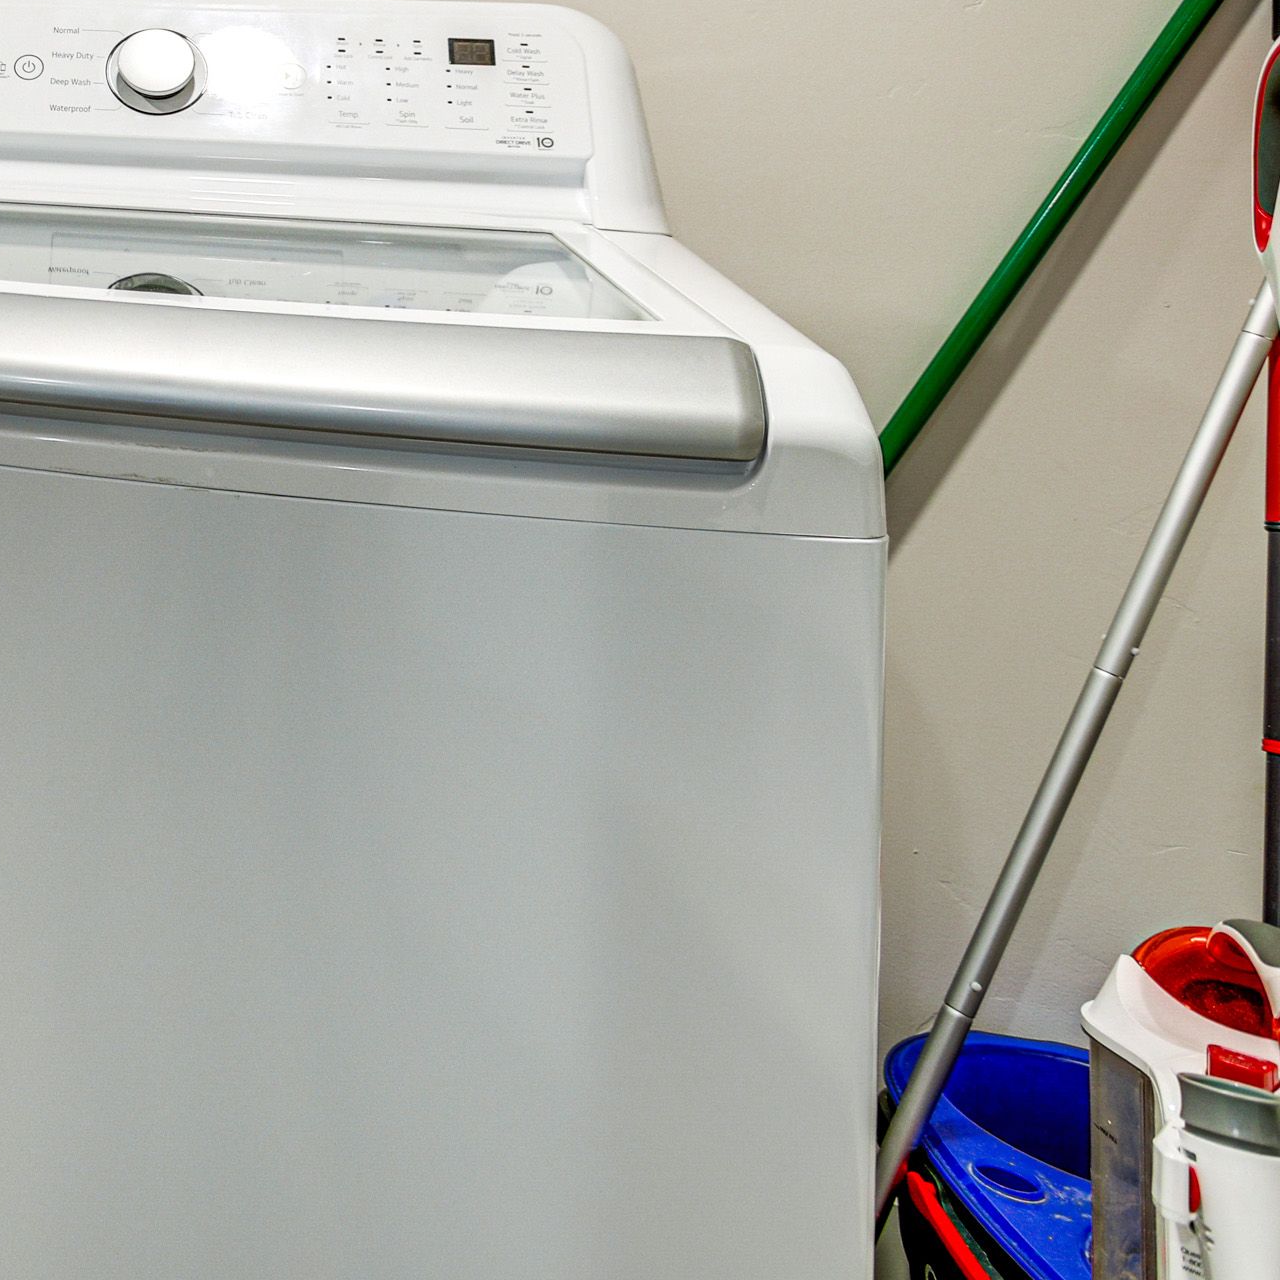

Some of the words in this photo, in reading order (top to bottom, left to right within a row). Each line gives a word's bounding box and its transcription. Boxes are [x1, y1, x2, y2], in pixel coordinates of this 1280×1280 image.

[53, 26, 80, 35] Normal
[507, 47, 522, 55] Cold
[523, 47, 541, 55] Wash
[51, 51, 74, 62] Heavy
[75, 51, 94, 61] Duty
[506, 69, 525, 78] Delay
[49, 77, 70, 88] Deep
[71, 78, 91, 86] Wash
[510, 92, 529, 100] Water
[530, 92, 546, 100] Plus
[456, 99, 473, 107] Light
[49, 104, 92, 114] Waterproof
[338, 110, 359, 119] Temp
[399, 110, 416, 119] Spin
[459, 116, 474, 124] Soil
[510, 116, 528, 124] Extra
[528, 116, 548, 124] Rinse
[536, 137, 554, 148] 10
